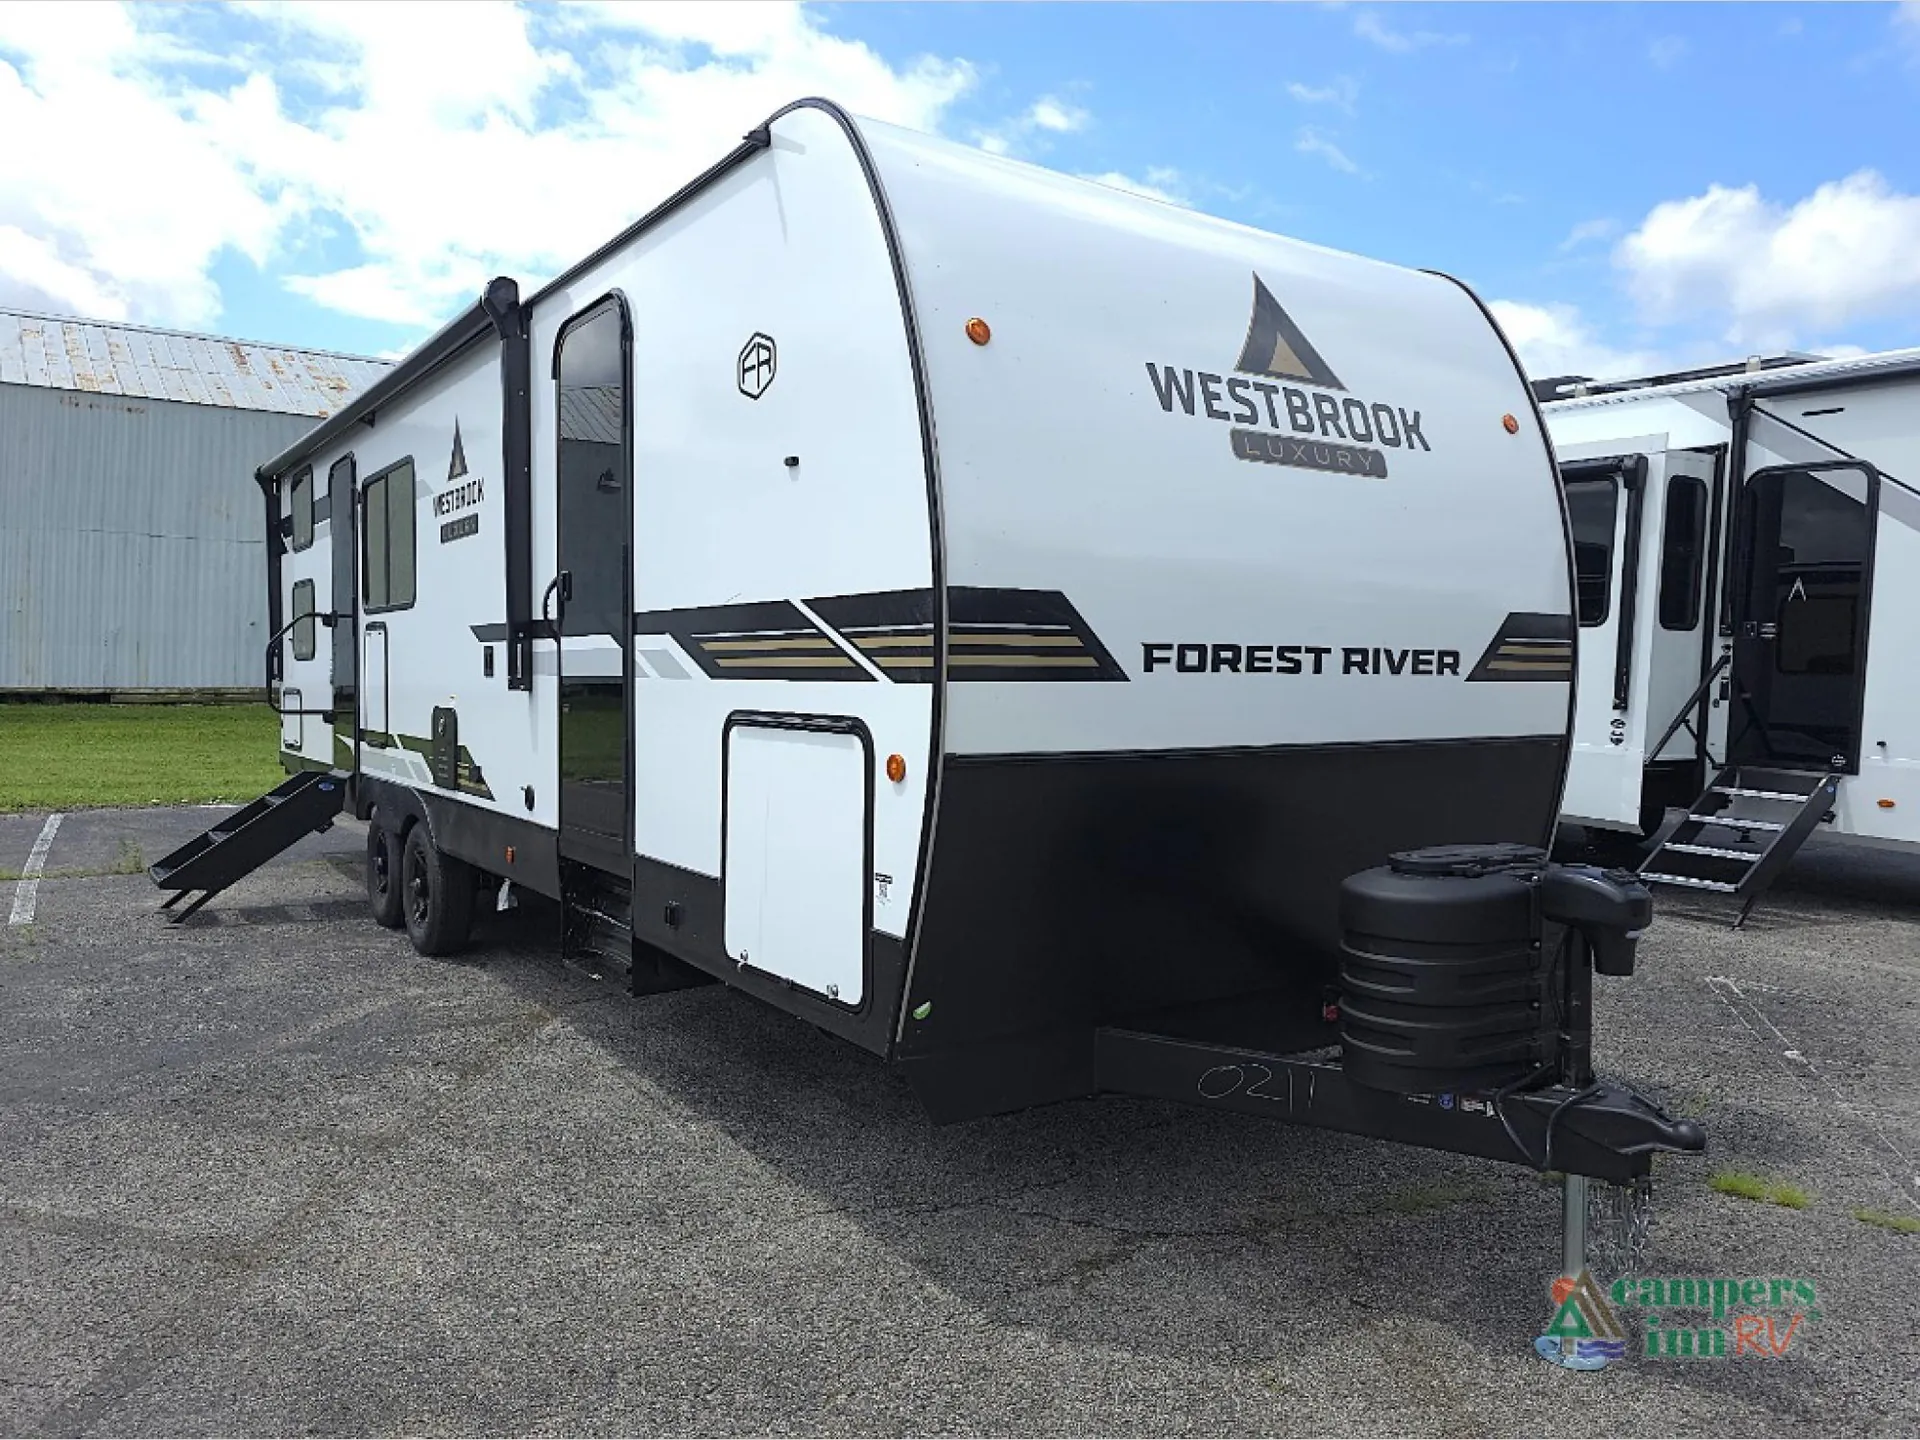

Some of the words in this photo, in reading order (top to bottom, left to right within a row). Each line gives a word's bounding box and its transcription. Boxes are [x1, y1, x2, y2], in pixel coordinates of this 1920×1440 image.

[1145, 361, 1431, 451] WESTBROOK
[1243, 436, 1373, 471] LUXURY
[1140, 642, 1332, 675] FOREST
[1341, 647, 1461, 677] RIVER
